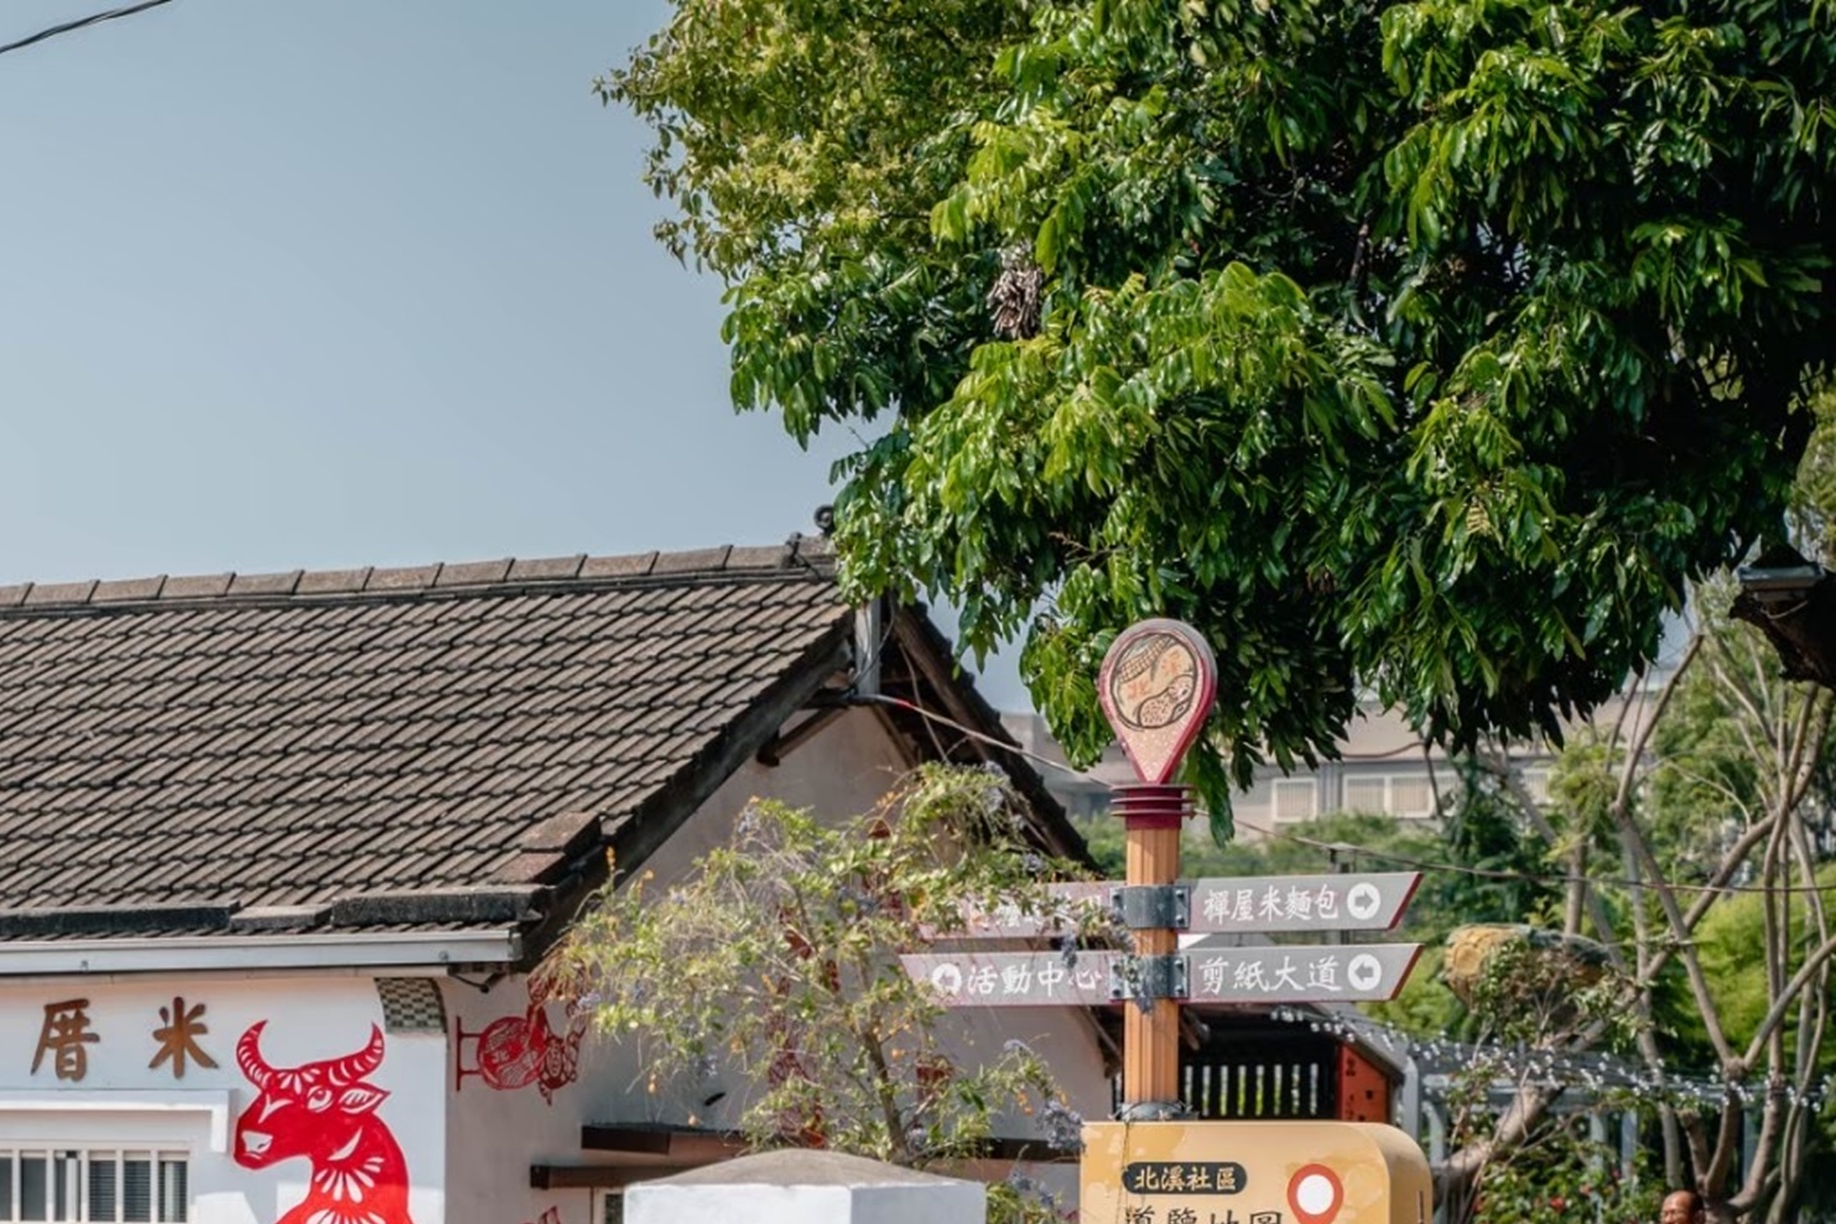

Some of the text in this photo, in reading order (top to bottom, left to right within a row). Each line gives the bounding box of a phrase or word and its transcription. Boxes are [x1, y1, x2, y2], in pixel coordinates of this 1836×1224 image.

[967, 961, 1102, 997] 活動中心
[1198, 955, 1342, 995] 剪紙大道
[1134, 1165, 1236, 1191] 北溪社區
